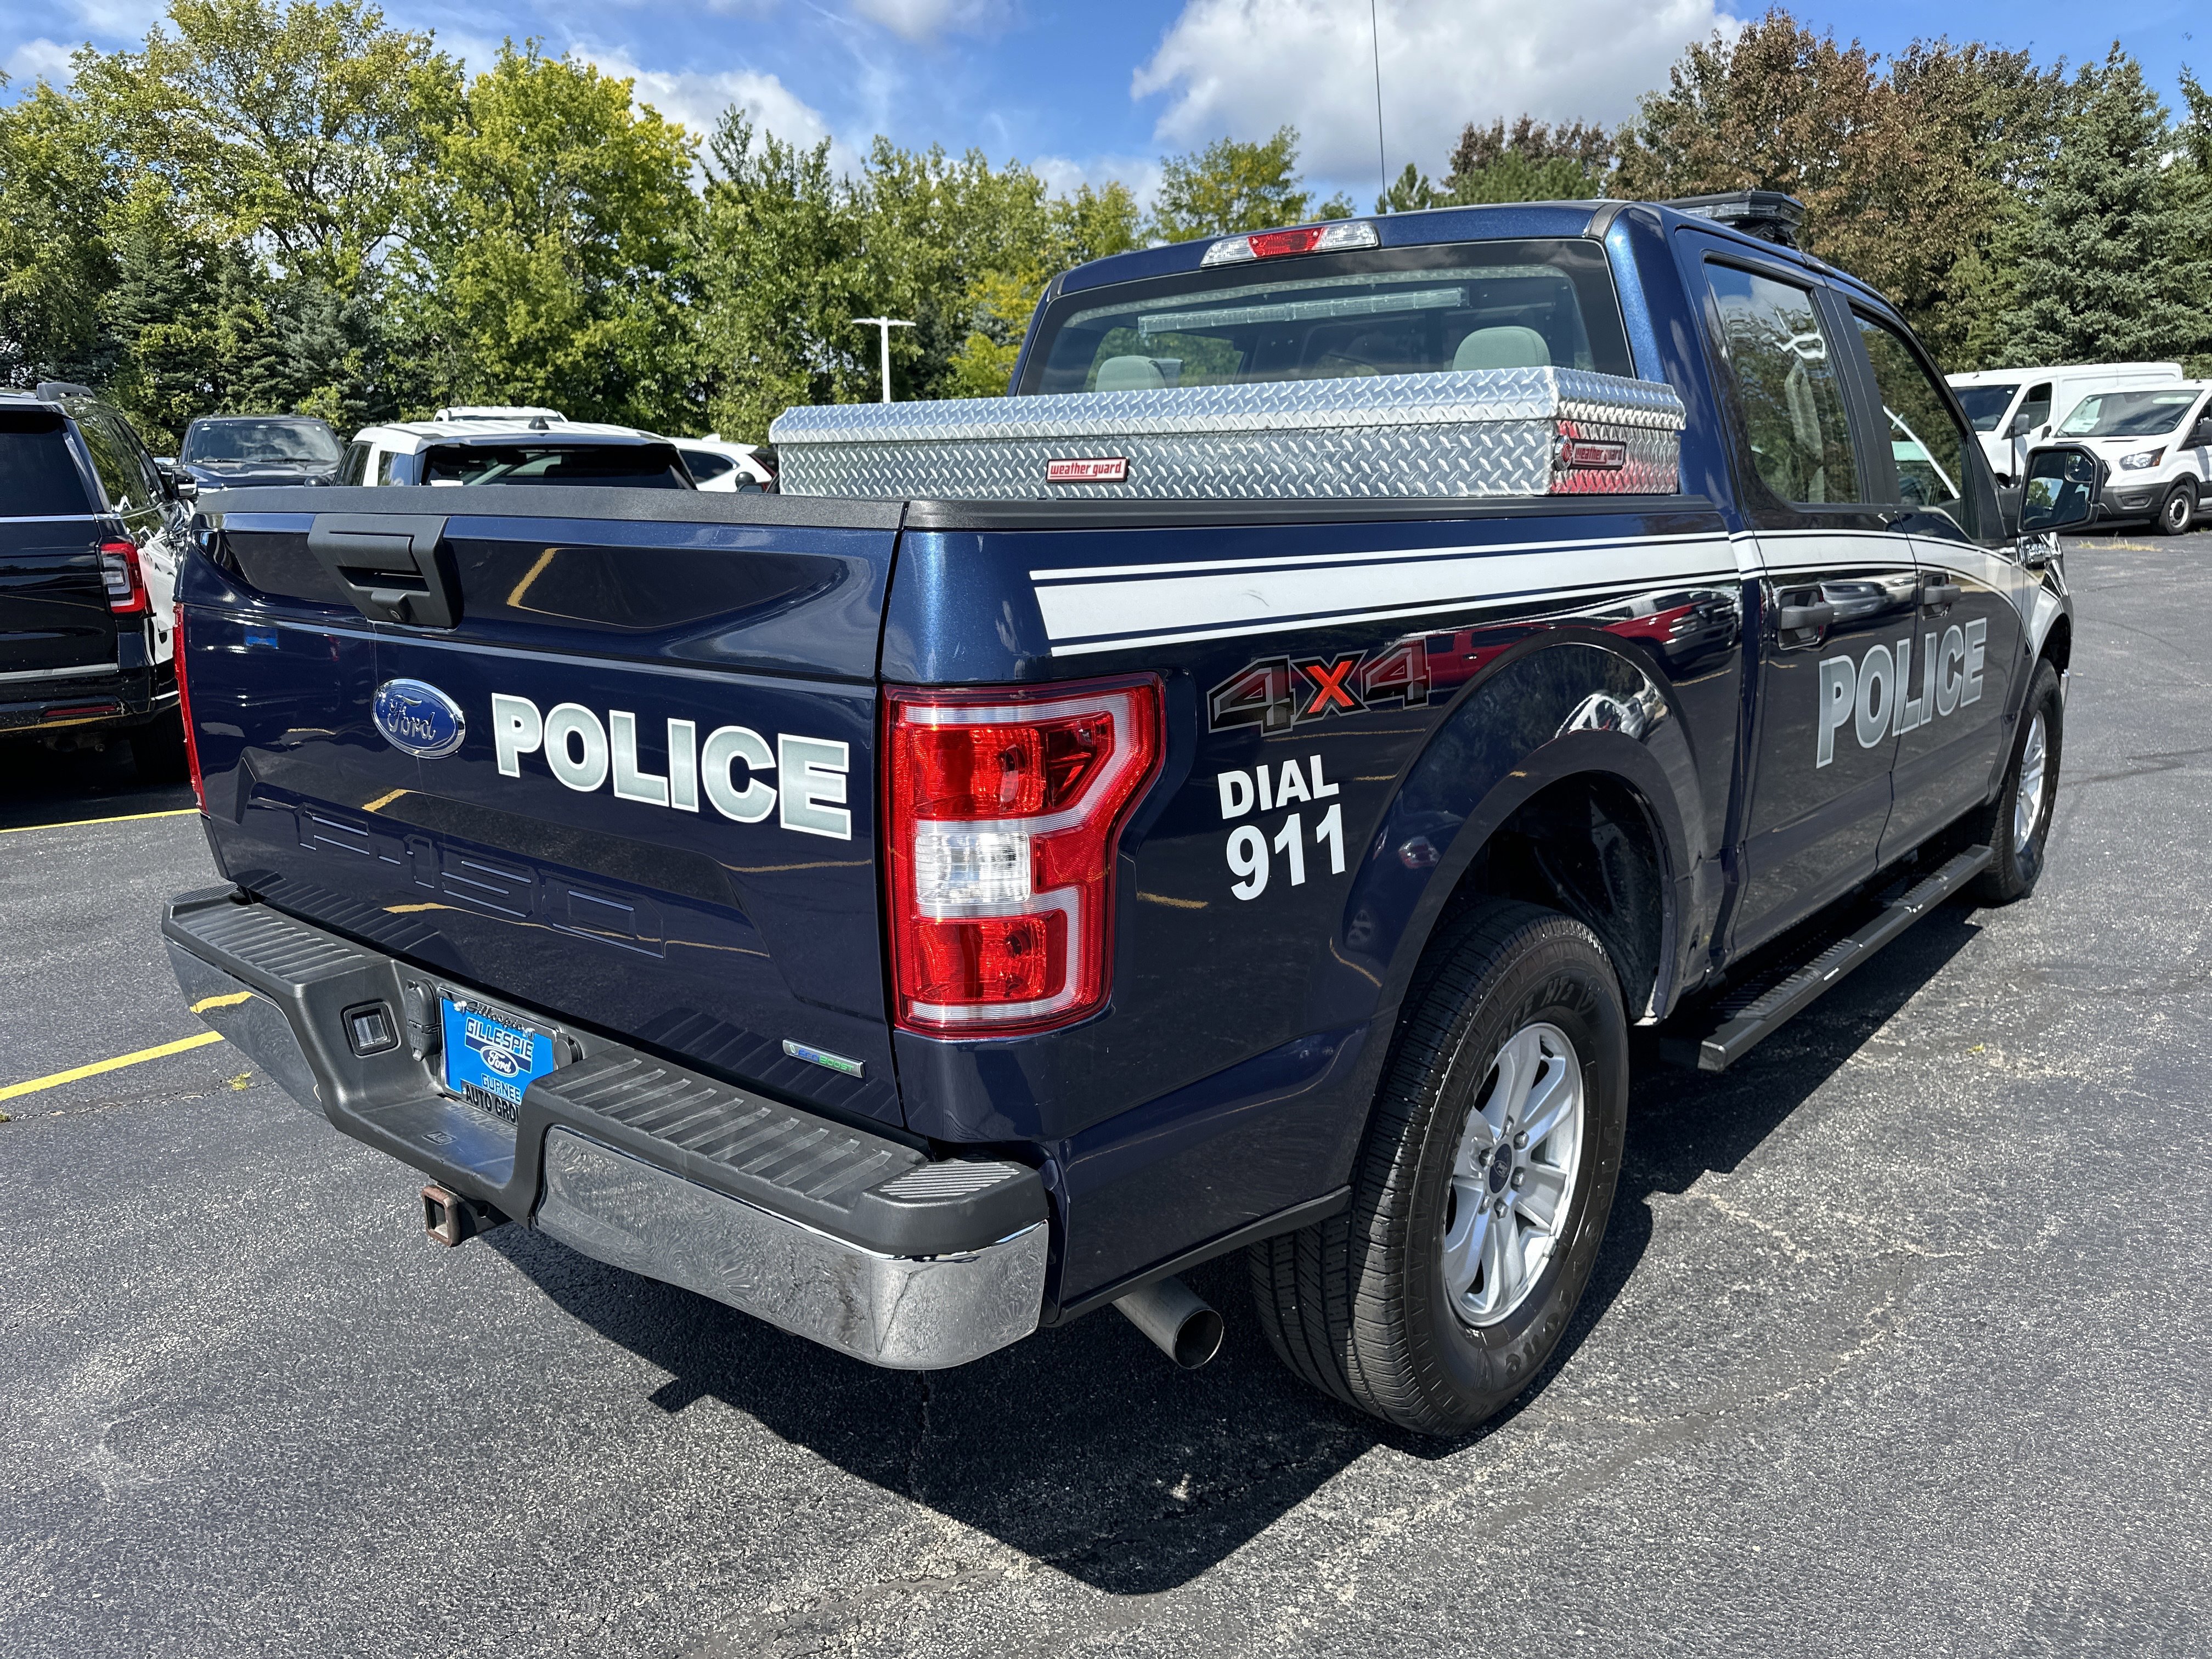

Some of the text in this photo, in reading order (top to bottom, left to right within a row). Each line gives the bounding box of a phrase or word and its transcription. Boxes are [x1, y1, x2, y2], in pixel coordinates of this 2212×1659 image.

[1050, 461, 1122, 477] weather guard
[1575, 446, 1604, 461] weather
[1816, 617, 1987, 769] POLICE
[387, 694, 437, 740] Ford
[492, 692, 851, 841] POLICE
[1217, 754, 1340, 820] DIAL
[1226, 803, 1346, 901] 911
[466, 1017, 534, 1058] GILLESPIE
[487, 1050, 511, 1073] Ford
[466, 1084, 519, 1124] AUTO GRO
[481, 1074, 521, 1103] GURNEE
